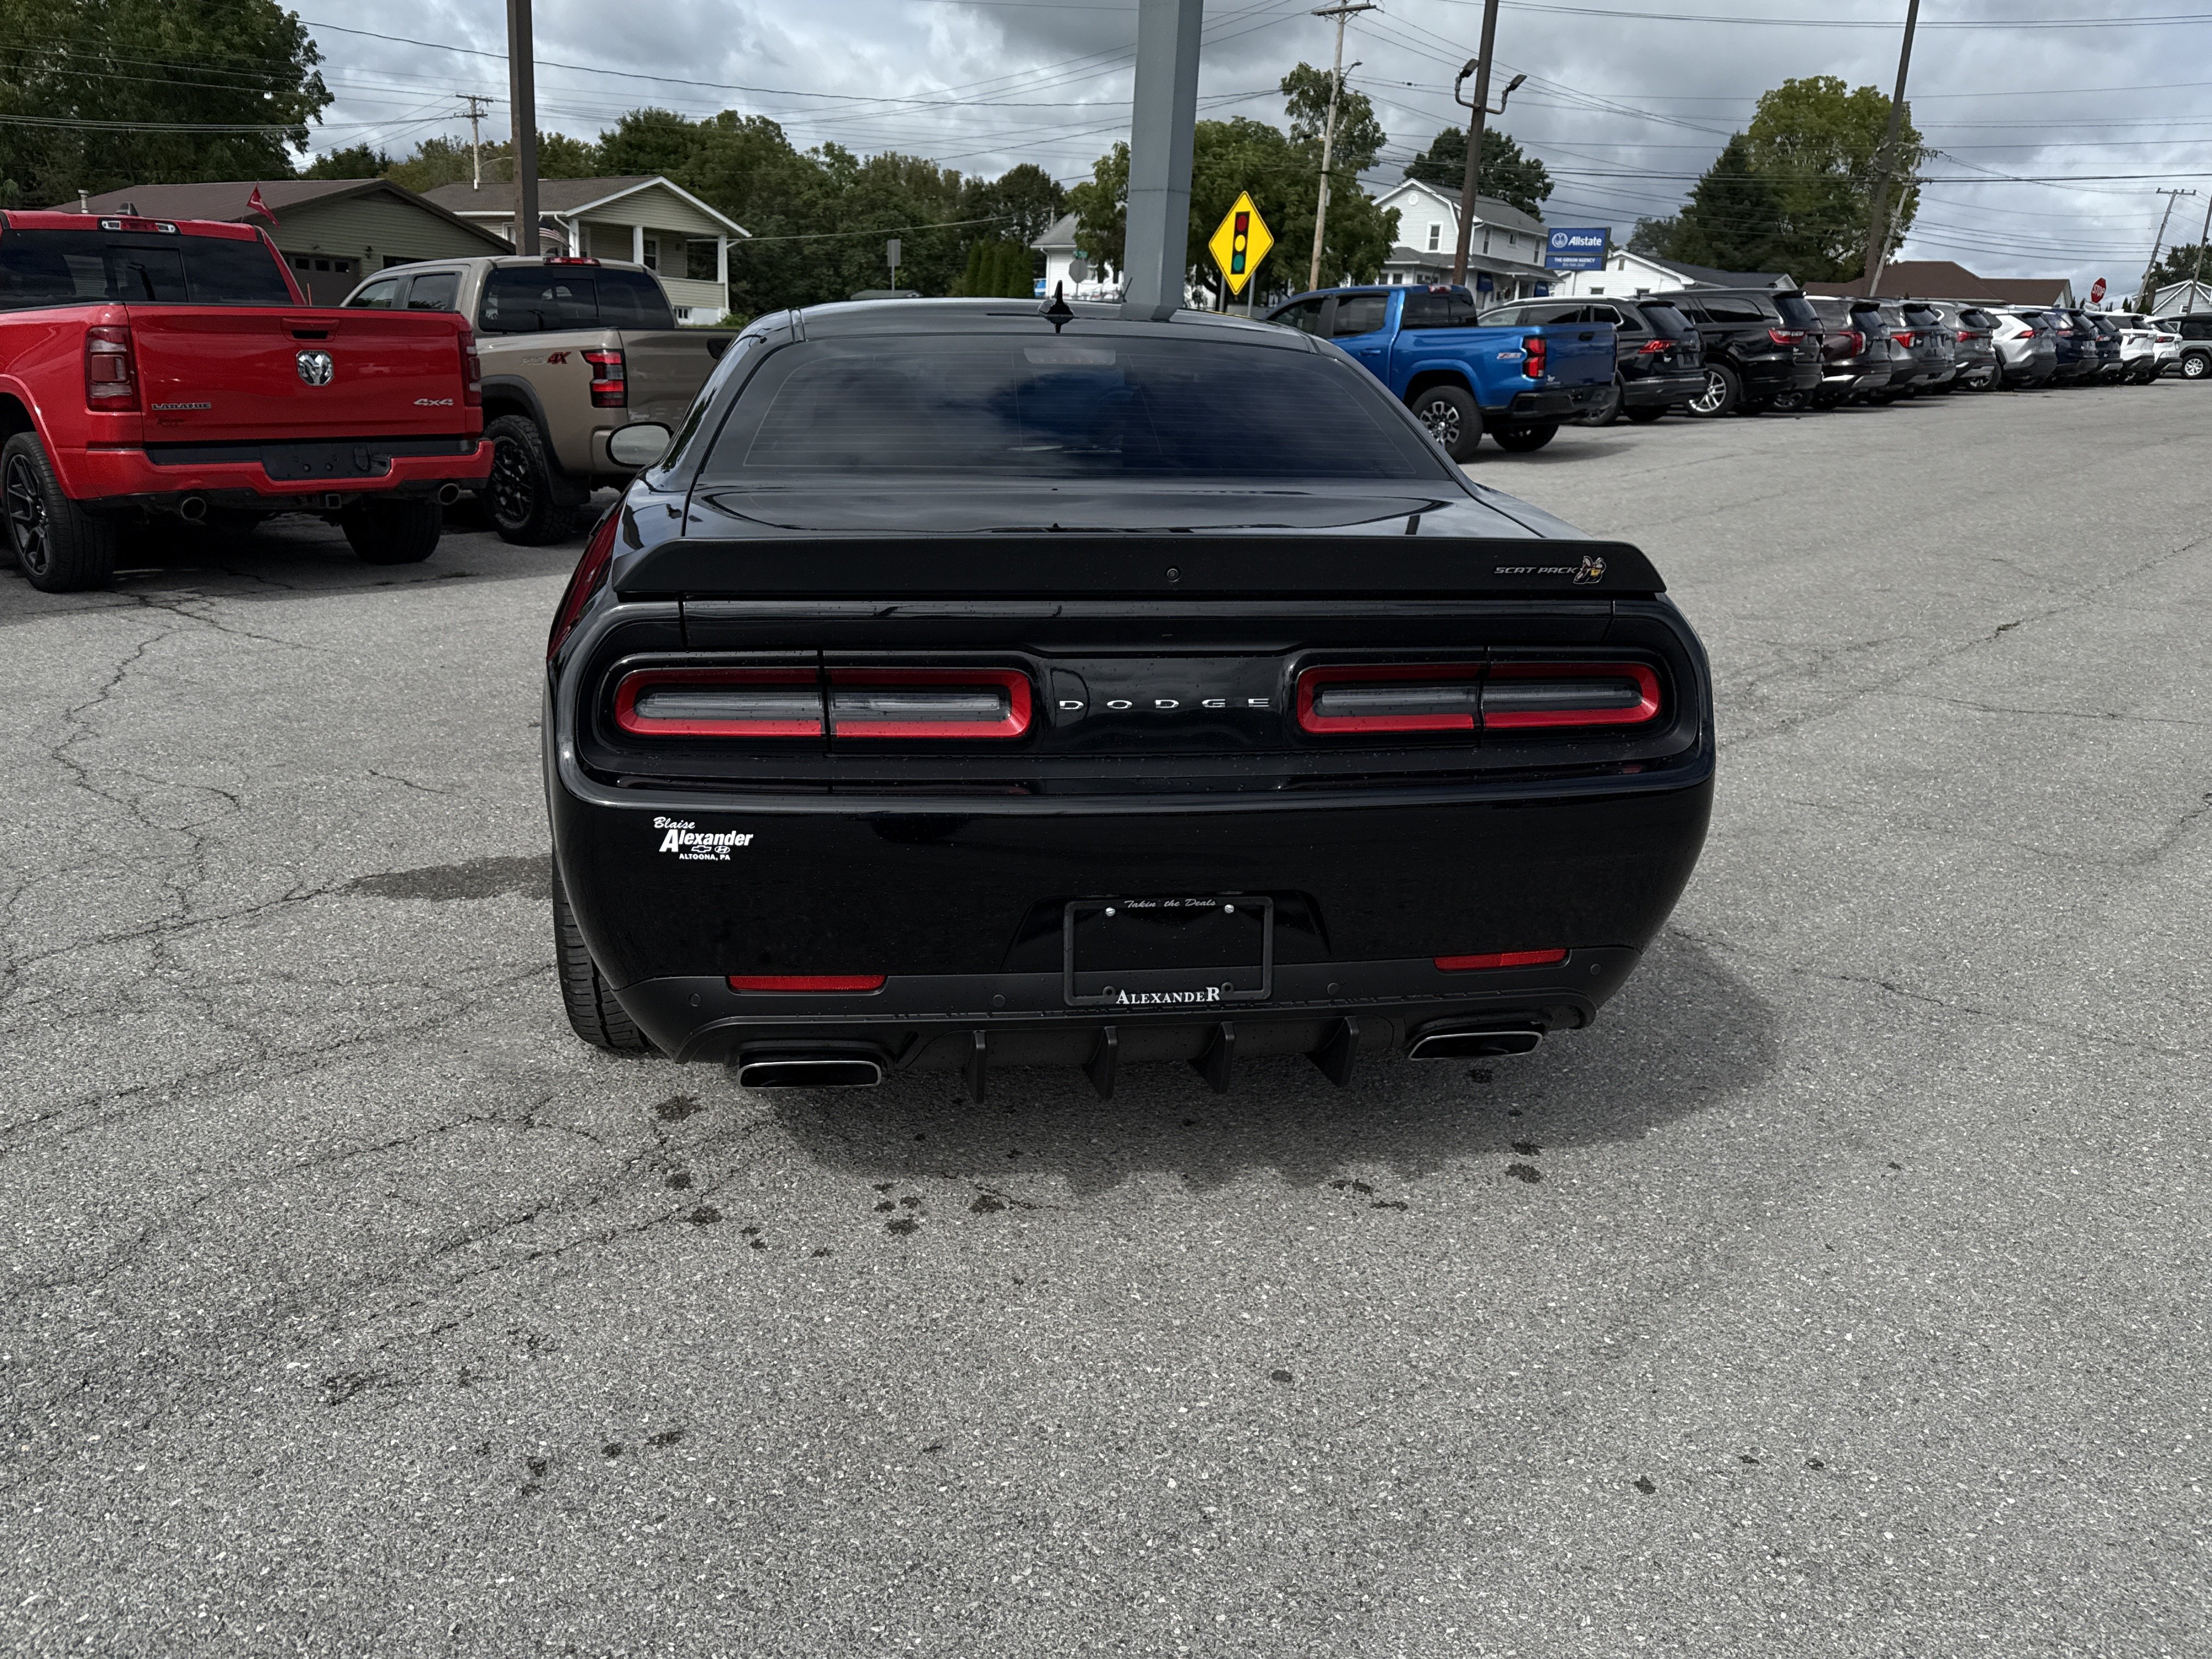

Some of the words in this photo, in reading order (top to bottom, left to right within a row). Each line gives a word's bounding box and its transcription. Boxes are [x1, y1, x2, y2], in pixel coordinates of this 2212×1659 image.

[1568, 236, 1602, 246] Allstate
[2092, 284, 2106, 297] STOP
[151, 402, 211, 410] LARAMIE
[1059, 698, 1269, 709] DODGE
[653, 816, 696, 828] Blaise
[659, 829, 754, 852] Alexander
[679, 853, 718, 861] ALTOONA,
[1184, 898, 1217, 906] Deals
[1116, 987, 1220, 1005] ALEXANDER
